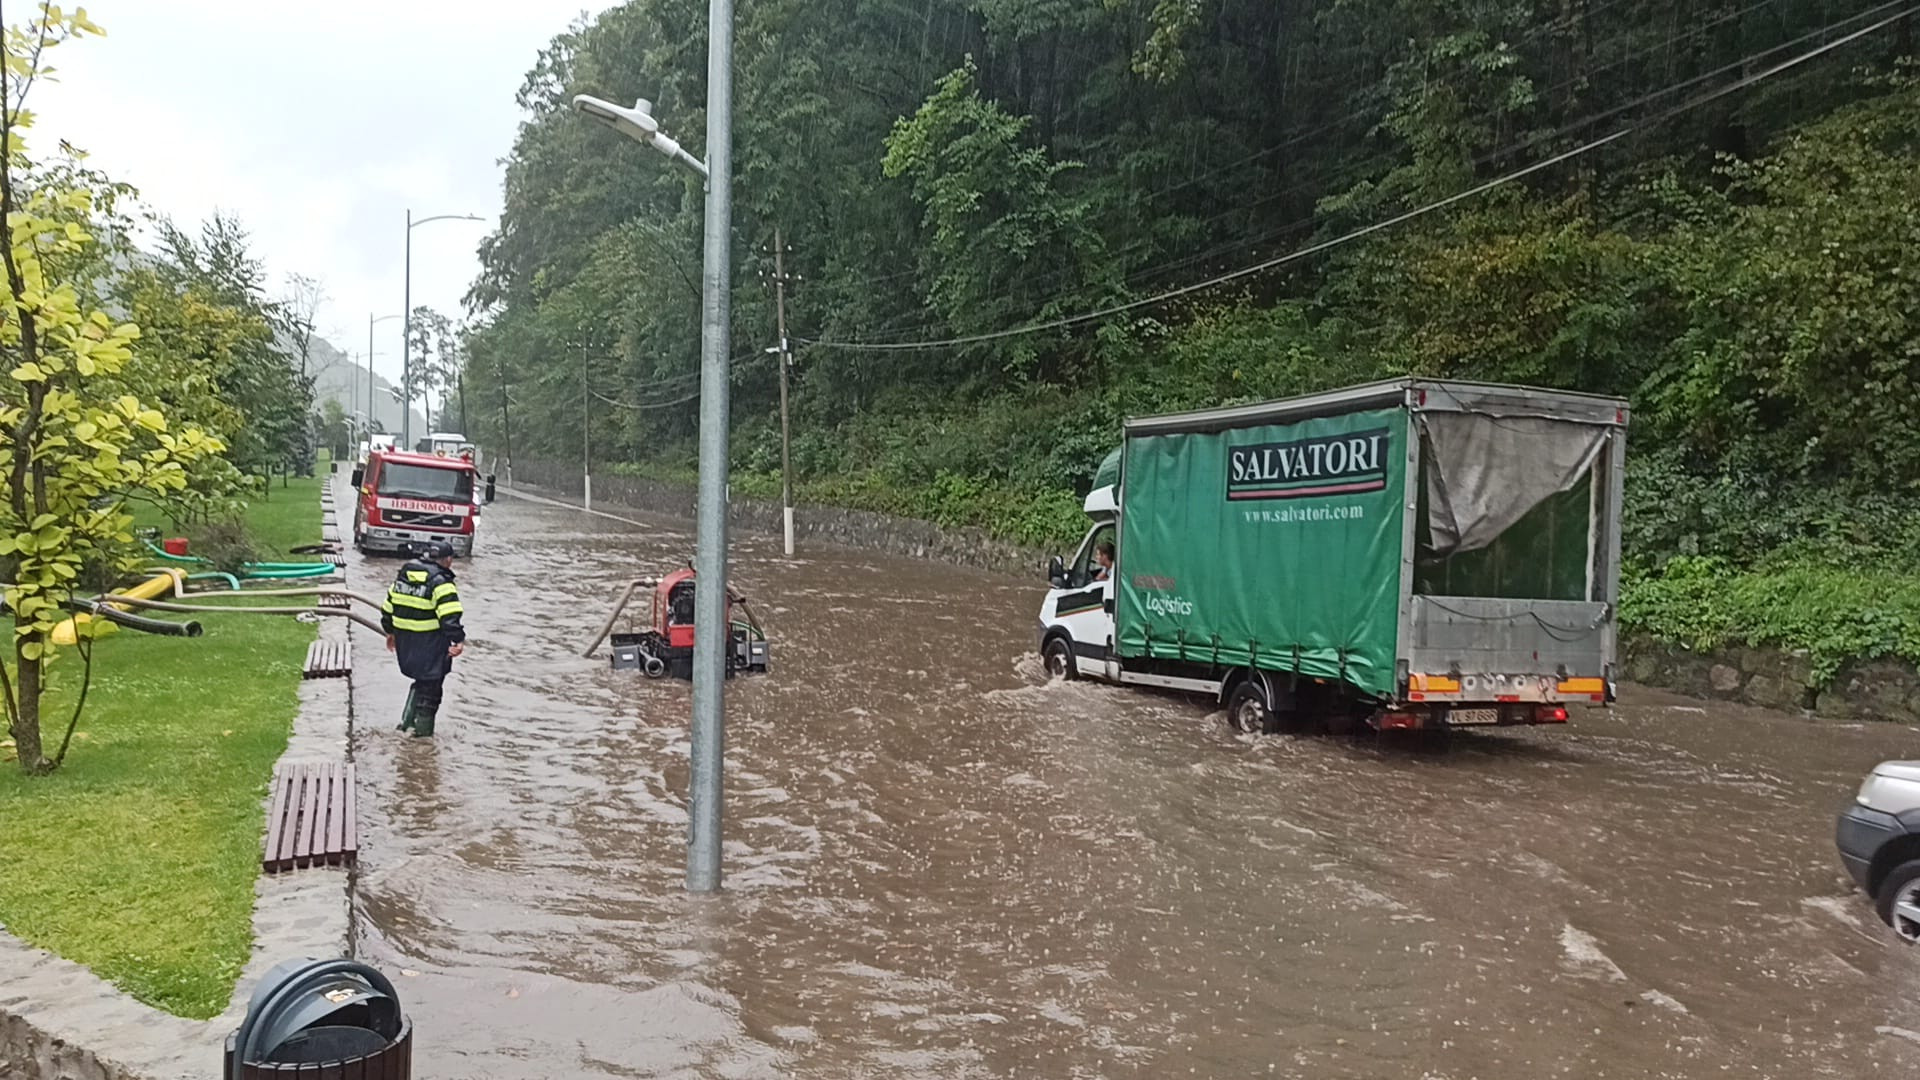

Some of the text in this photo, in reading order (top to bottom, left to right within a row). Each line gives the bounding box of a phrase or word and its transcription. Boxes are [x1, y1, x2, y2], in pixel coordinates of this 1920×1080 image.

[1232, 436, 1381, 482] SALVATORI
[1244, 504, 1364, 523] www.salvatori.com
[1146, 592, 1192, 616] Logistics
